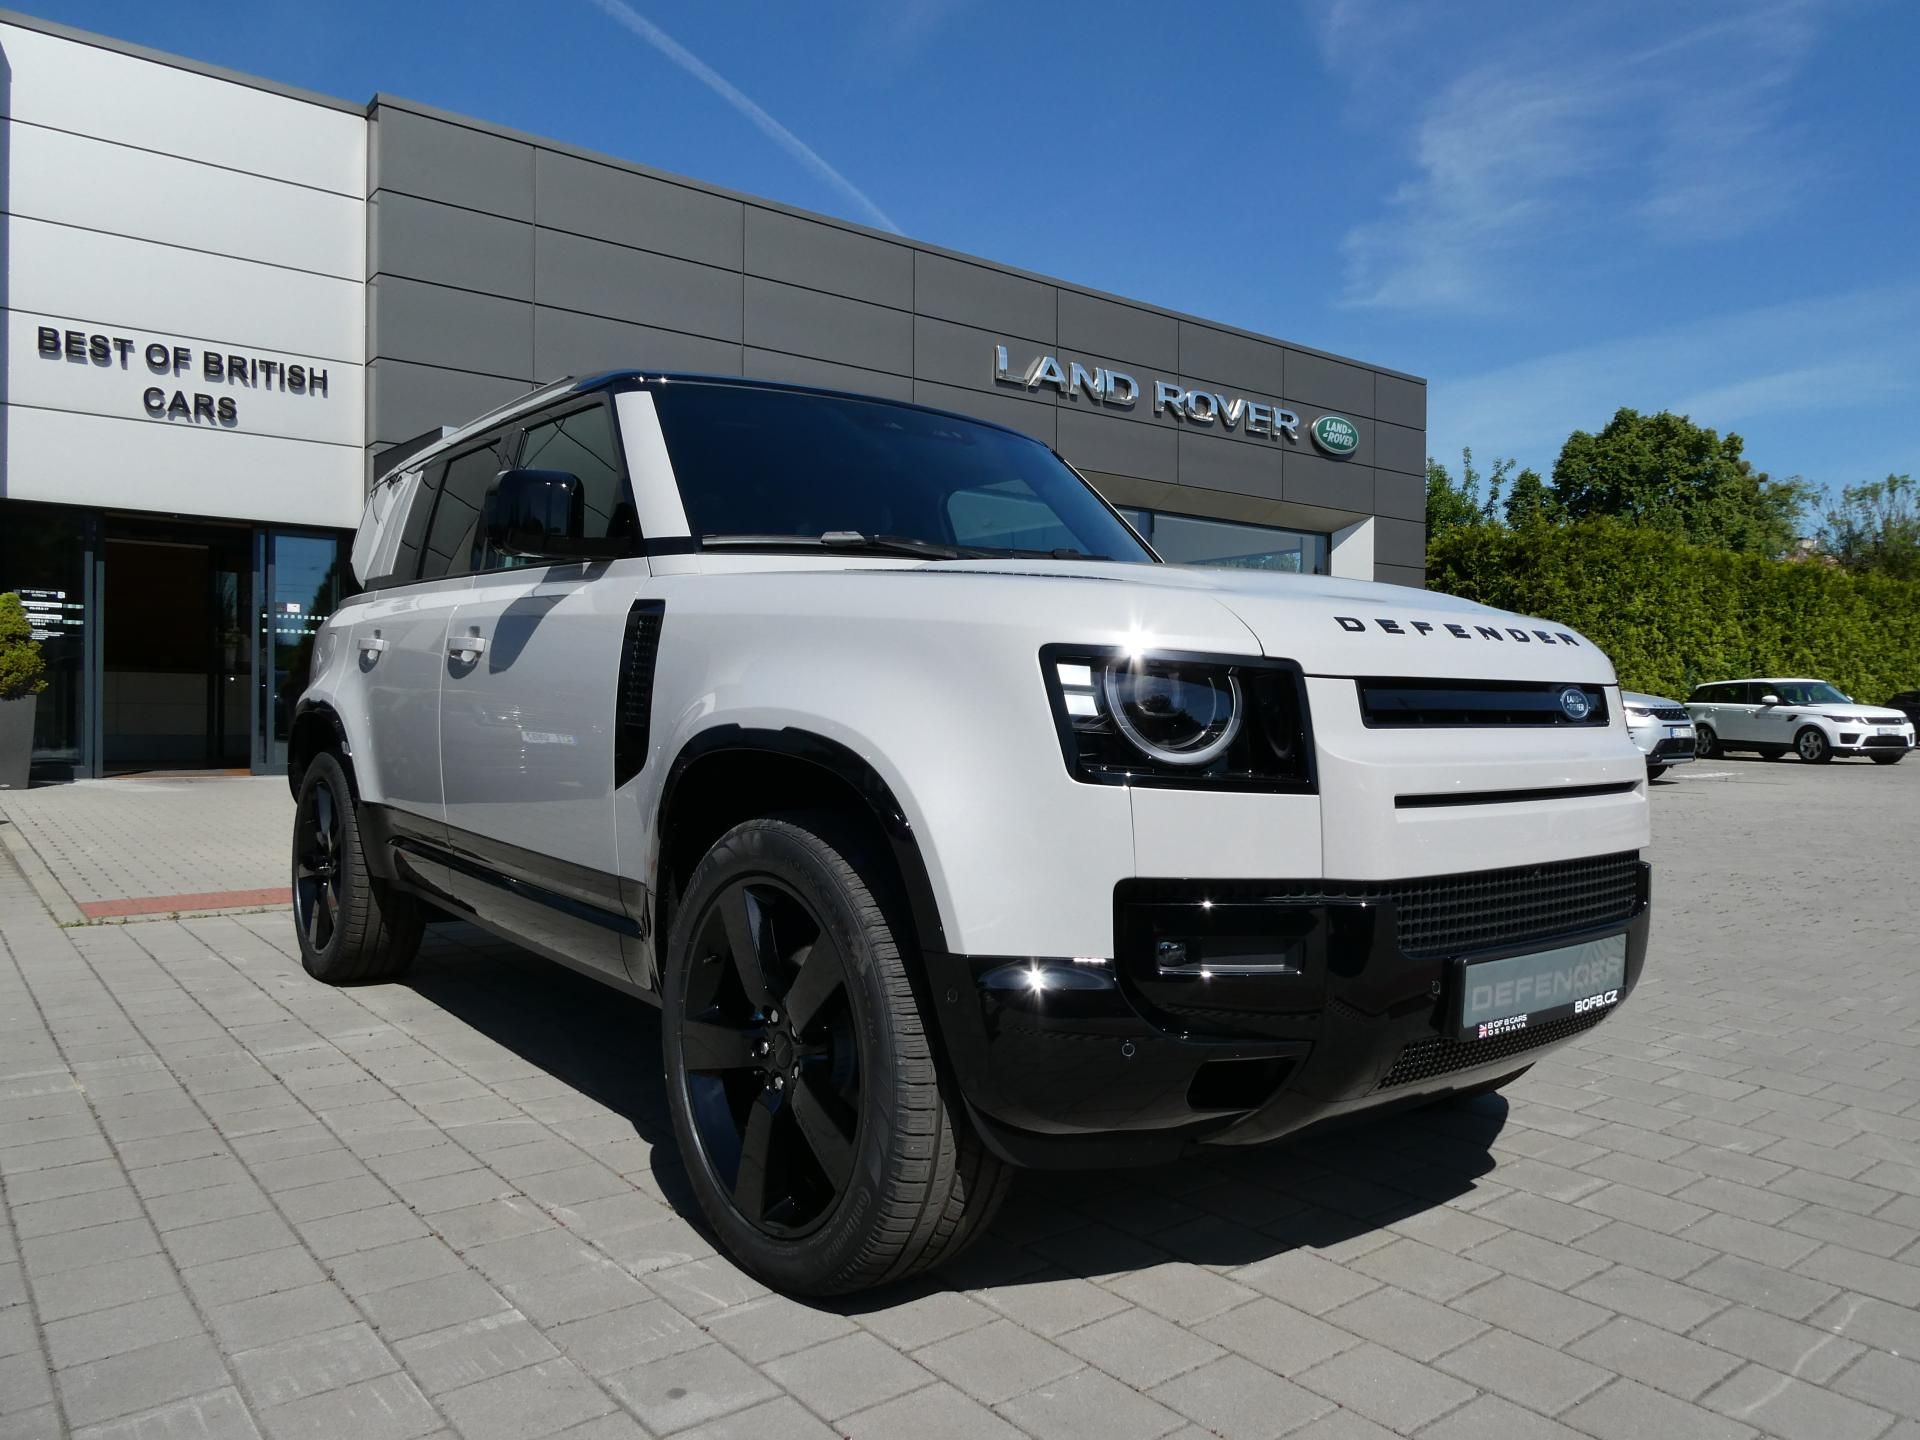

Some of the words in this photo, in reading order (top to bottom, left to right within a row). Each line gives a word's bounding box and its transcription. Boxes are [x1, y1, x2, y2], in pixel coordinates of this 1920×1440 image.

[37, 326, 134, 364] BEST
[145, 343, 191, 371] OF
[203, 351, 328, 392] BRITISH
[143, 387, 237, 421] CARS
[995, 344, 1140, 405] LAND
[1154, 380, 1300, 440] ROVER
[1325, 420, 1348, 434] LAND
[1327, 432, 1354, 447] ROVER
[1334, 616, 1580, 646] DEFENDER
[1574, 990, 1618, 1014] BOFB.CZ
[1487, 1022, 1526, 1036] OSTRAVA
